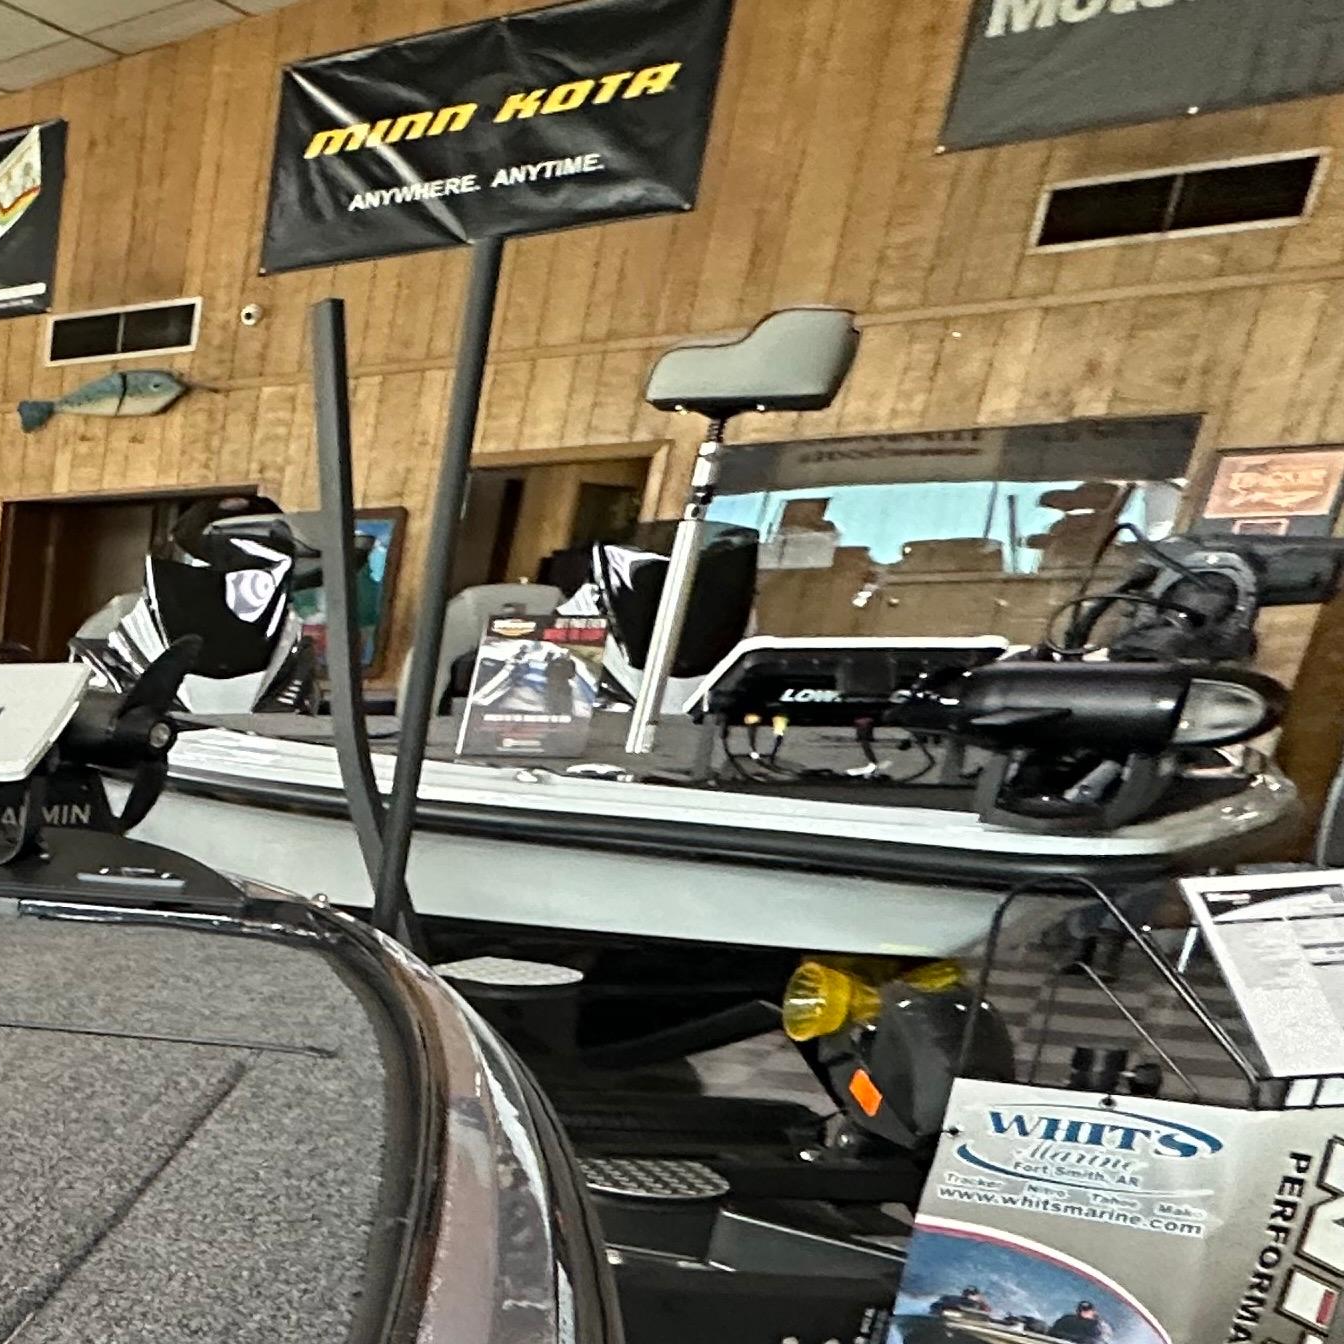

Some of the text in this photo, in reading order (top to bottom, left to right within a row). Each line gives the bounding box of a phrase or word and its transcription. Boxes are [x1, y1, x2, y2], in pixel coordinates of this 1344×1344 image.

[303, 61, 683, 160] MINN KOTA
[347, 153, 606, 212] ANYWHERE. ANYTIME.
[988, 1110, 1200, 1159] WHIT'S
[946, 1172, 1003, 1189] Tracker
[1013, 1161, 1048, 1175] Fort
[1115, 1174, 1140, 1188] AR
[938, 1187, 1203, 1236] www.whitsmarine.com
